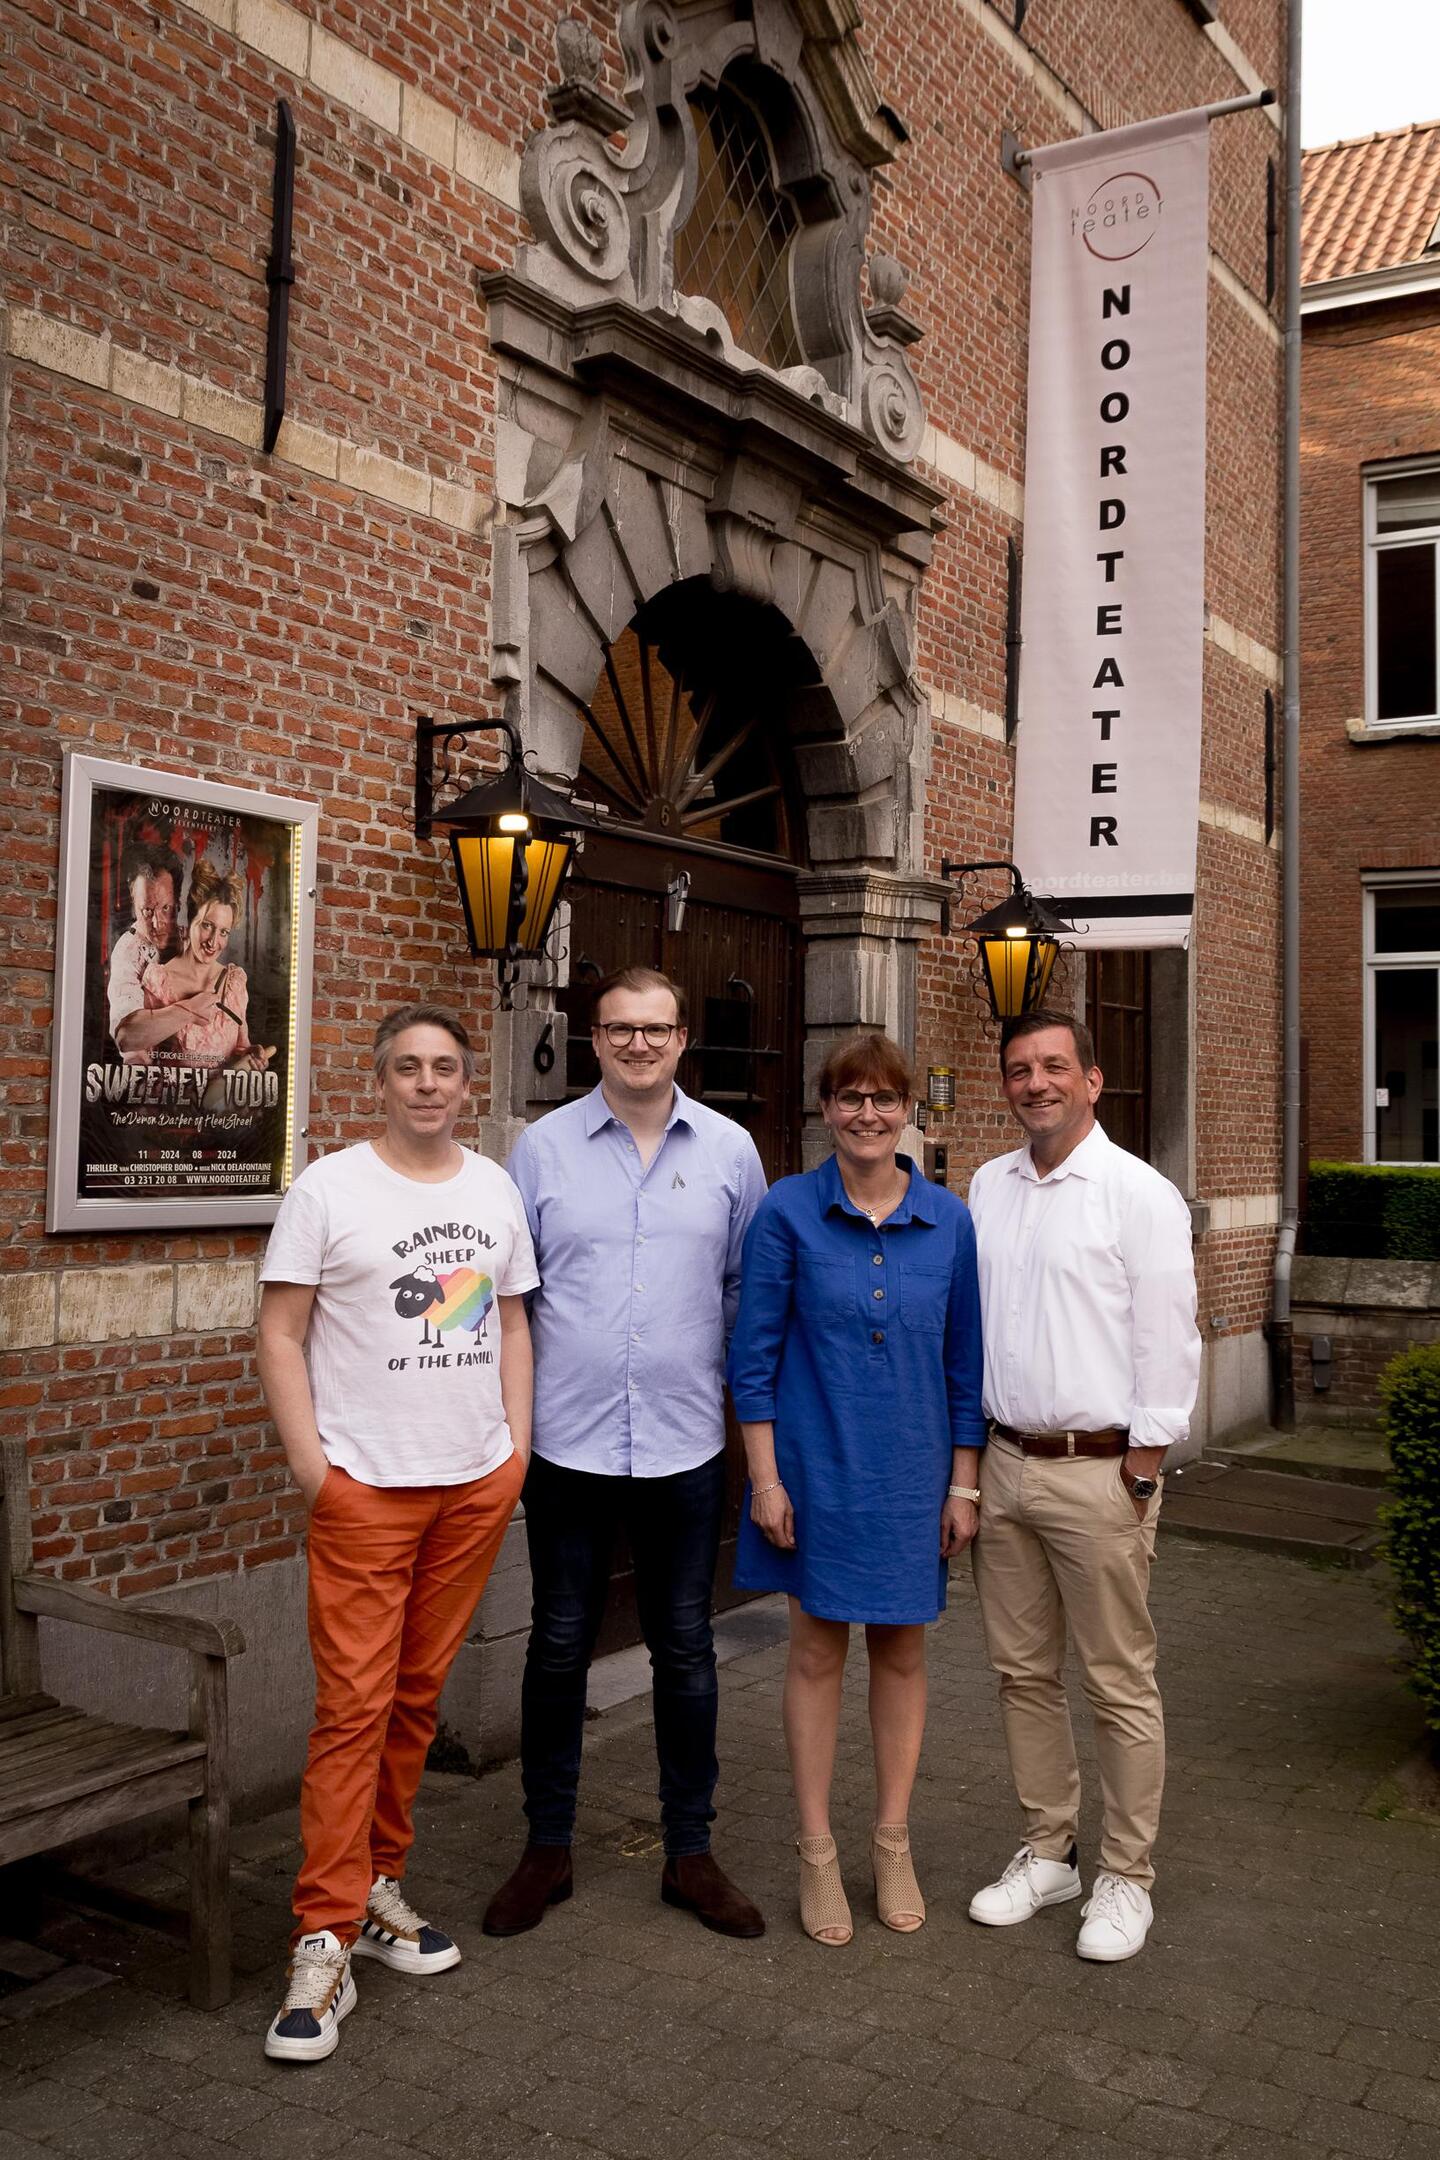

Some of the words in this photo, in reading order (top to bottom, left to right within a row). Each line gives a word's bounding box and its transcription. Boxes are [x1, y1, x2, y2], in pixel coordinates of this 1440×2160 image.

[1071, 192, 1144, 218] NOORD
[1071, 201, 1165, 236] teater
[1089, 284, 1132, 848] NOORDTEATER
[151, 802, 241, 827] NOORDTEATER
[660, 804, 670, 826] 6
[534, 1023, 555, 1074] 6
[85, 1063, 209, 1107] SWEENEY
[222, 1069, 280, 1109] TODD
[110, 1111, 127, 1126] The
[127, 1111, 157, 1126] Demon
[138, 1150, 148, 1160] 11
[160, 1150, 180, 1160] 2024
[192, 1150, 203, 1160] 08
[217, 1150, 237, 1160] 2024
[86, 1163, 118, 1173] THRILLER
[129, 1163, 173, 1173] CHRISTOPHER
[174, 1163, 194, 1172] BOND
[210, 1163, 226, 1172] NICK
[227, 1162, 272, 1172] DELAFONTAINE
[124, 1175, 135, 1185] 03
[138, 1175, 153, 1185] 231
[155, 1175, 166, 1185] 20
[167, 1175, 178, 1184] 08
[186, 1174, 271, 1184] WWW.NOORDTEATER.BE
[392, 1222, 498, 1260] RAINBOW
[424, 1248, 476, 1266] SHEEP
[387, 1357, 411, 1372] OF
[417, 1353, 452, 1370] THE
